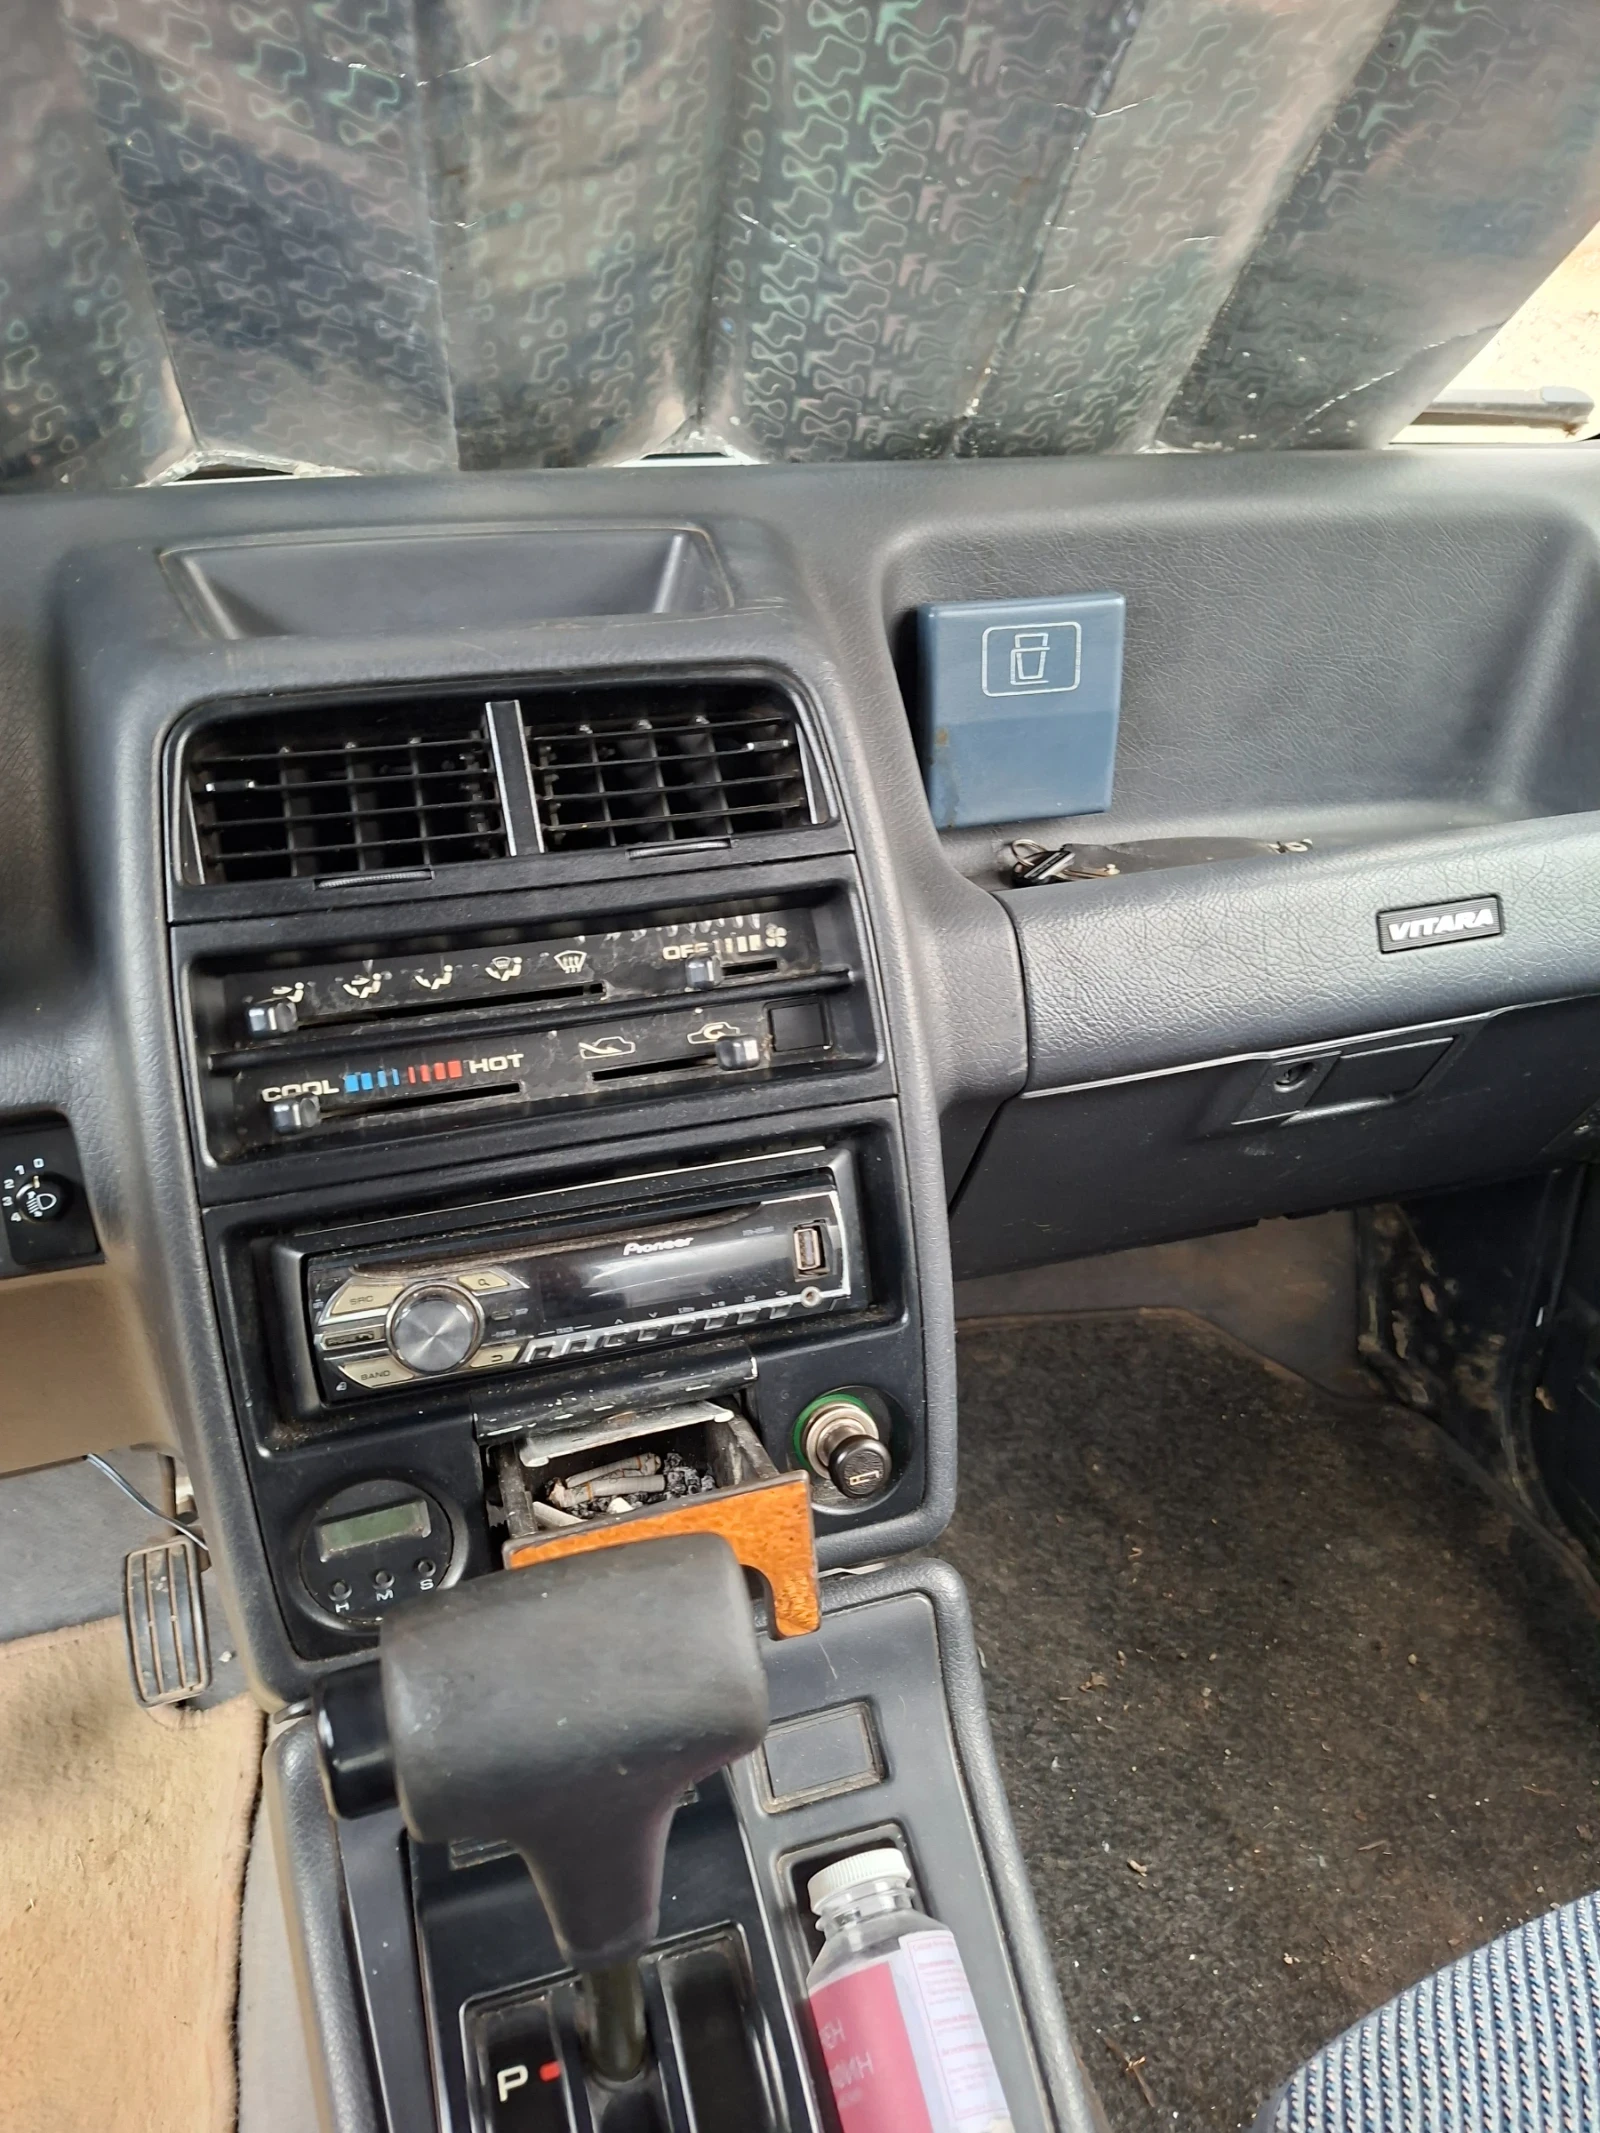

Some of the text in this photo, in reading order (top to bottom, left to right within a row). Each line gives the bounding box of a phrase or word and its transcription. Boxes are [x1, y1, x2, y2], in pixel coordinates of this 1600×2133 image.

[1388, 908, 1494, 941] VITARA
[662, 942, 709, 960] OFF
[468, 1053, 524, 1074] HOT
[261, 1079, 340, 1103] COOL
[33, 1158, 44, 1168] 0
[15, 1165, 25, 1175] 1
[4, 1179, 15, 1189] 2
[2, 1196, 13, 1206] 3
[11, 1212, 21, 1221] 4
[623, 1237, 695, 1257] Pioneer
[360, 1368, 391, 1382] BAND
[419, 1578, 435, 1591] S
[376, 1589, 394, 1601] M
[335, 1602, 350, 1613] H
[497, 2064, 529, 2103] P
